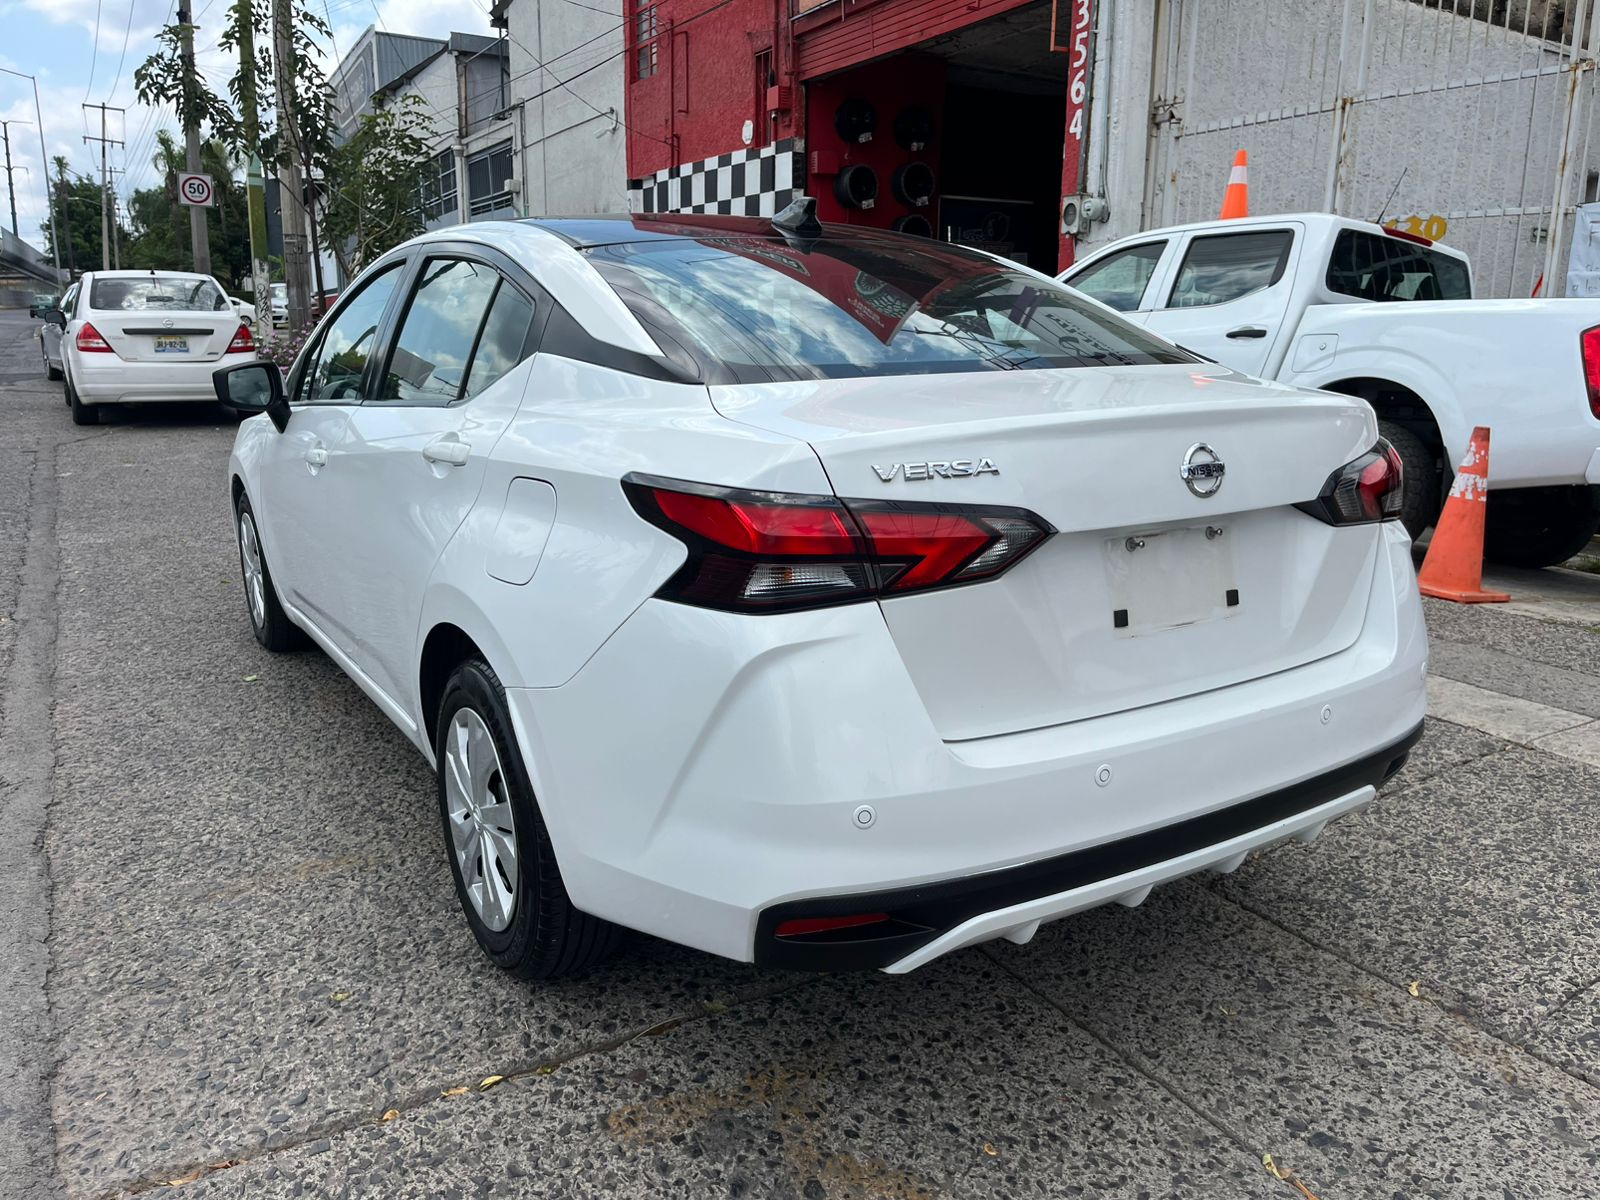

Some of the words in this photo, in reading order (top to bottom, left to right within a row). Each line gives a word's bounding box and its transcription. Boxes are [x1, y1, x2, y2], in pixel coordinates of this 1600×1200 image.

[1069, 0, 1090, 140] 3564
[188, 182, 205, 195] 50
[870, 457, 1001, 483] VERSA
[1187, 462, 1224, 478] NISSAN
